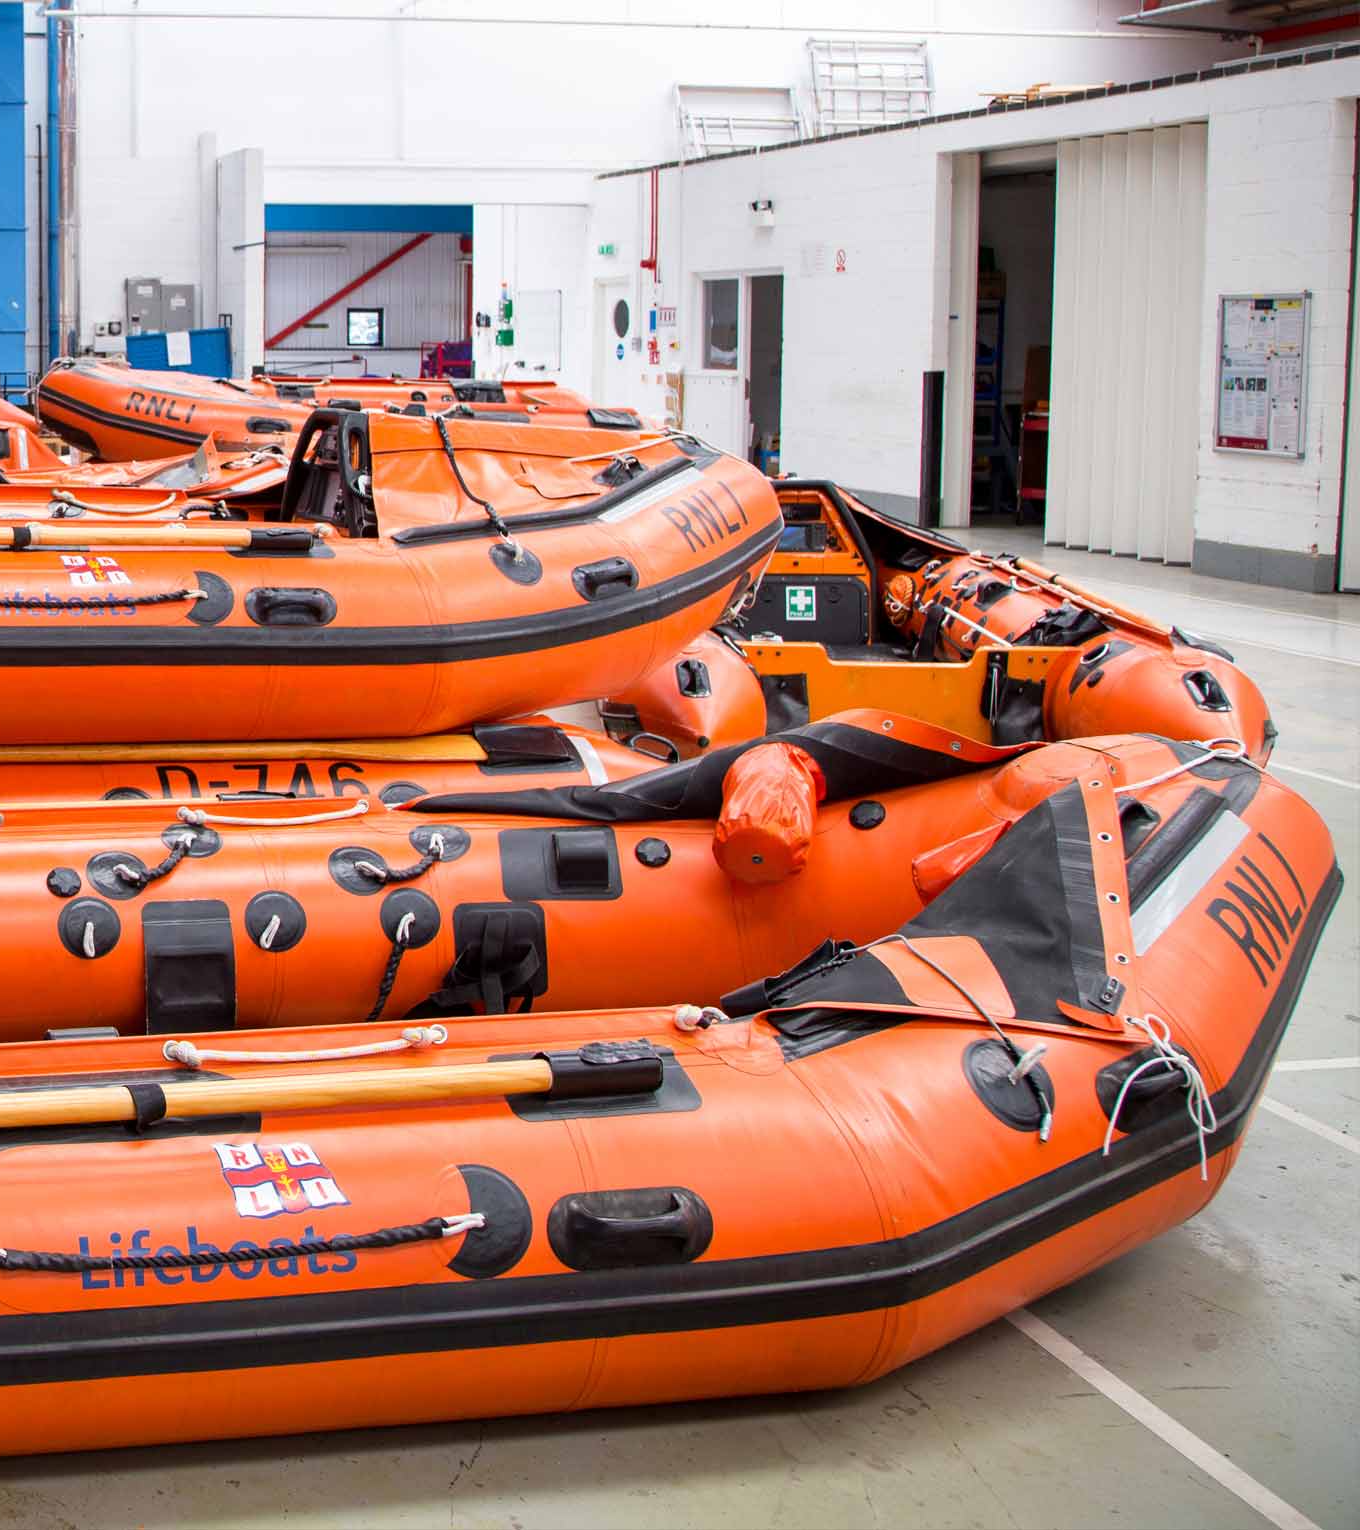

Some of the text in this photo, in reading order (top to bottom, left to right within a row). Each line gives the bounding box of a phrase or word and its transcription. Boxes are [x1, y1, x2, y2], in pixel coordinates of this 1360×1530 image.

[125, 391, 196, 424] RNLI
[662, 481, 748, 552] RNLI
[155, 762, 370, 799] D-746
[1205, 832, 1308, 988] RNLI
[78, 1225, 358, 1290] Lifeboats
